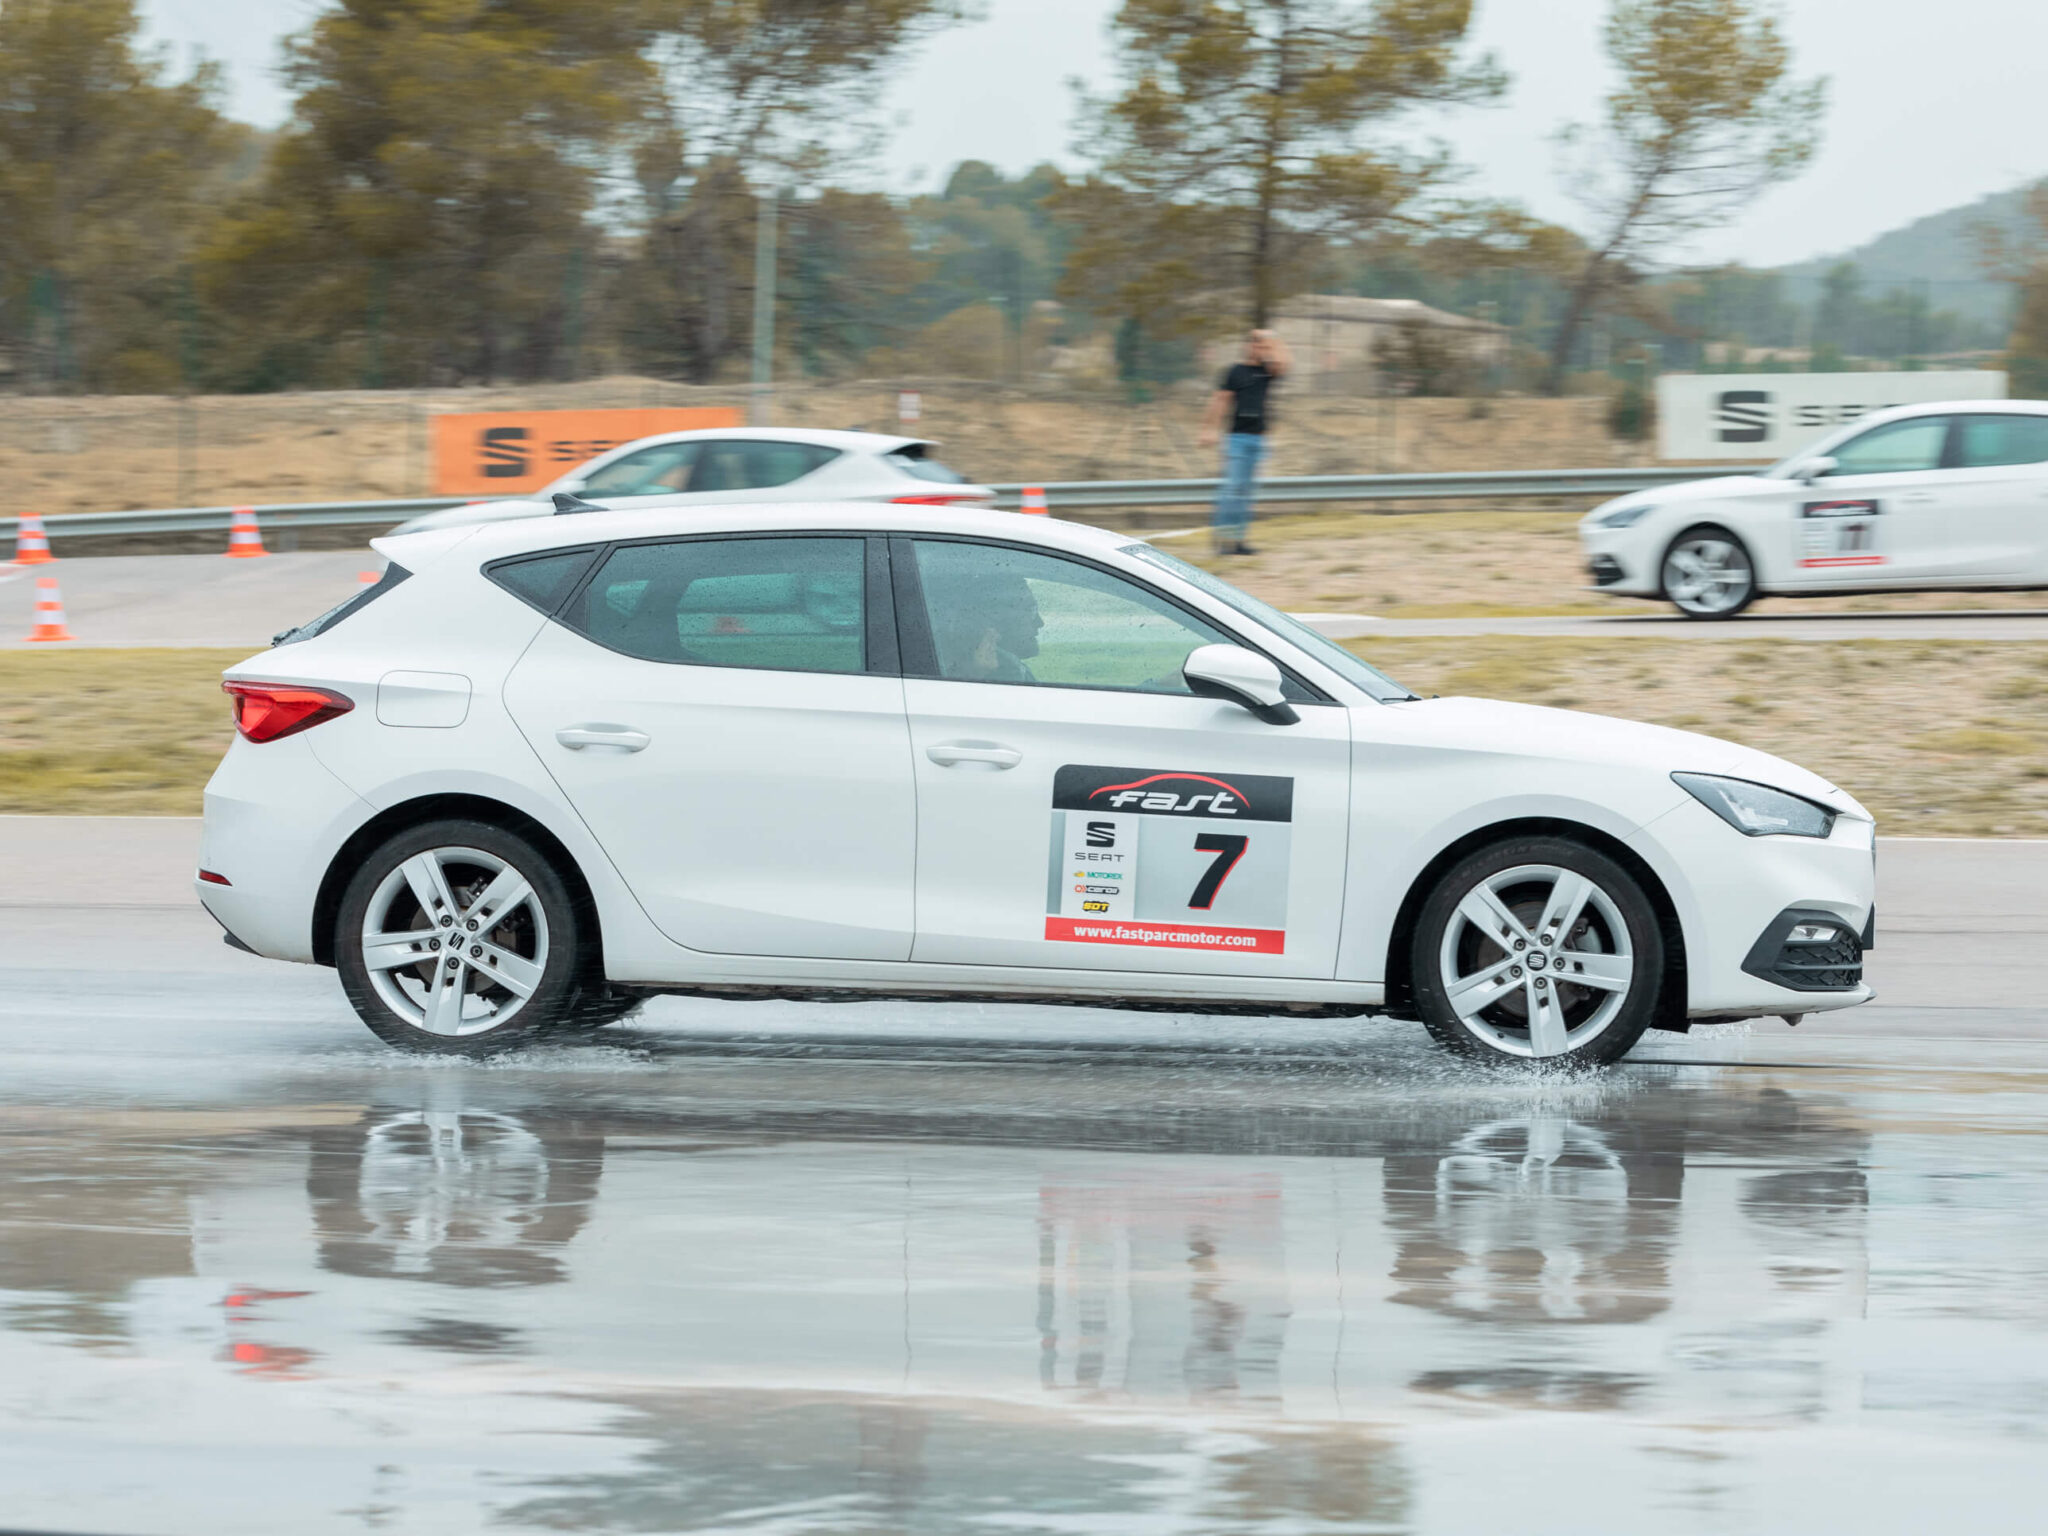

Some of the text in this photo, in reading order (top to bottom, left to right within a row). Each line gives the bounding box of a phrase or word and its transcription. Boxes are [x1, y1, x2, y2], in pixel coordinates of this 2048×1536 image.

[1075, 852, 1125, 863] SEAT
[1187, 832, 1250, 911] 7
[1073, 925, 1257, 947] www.fastparcmotor.com
